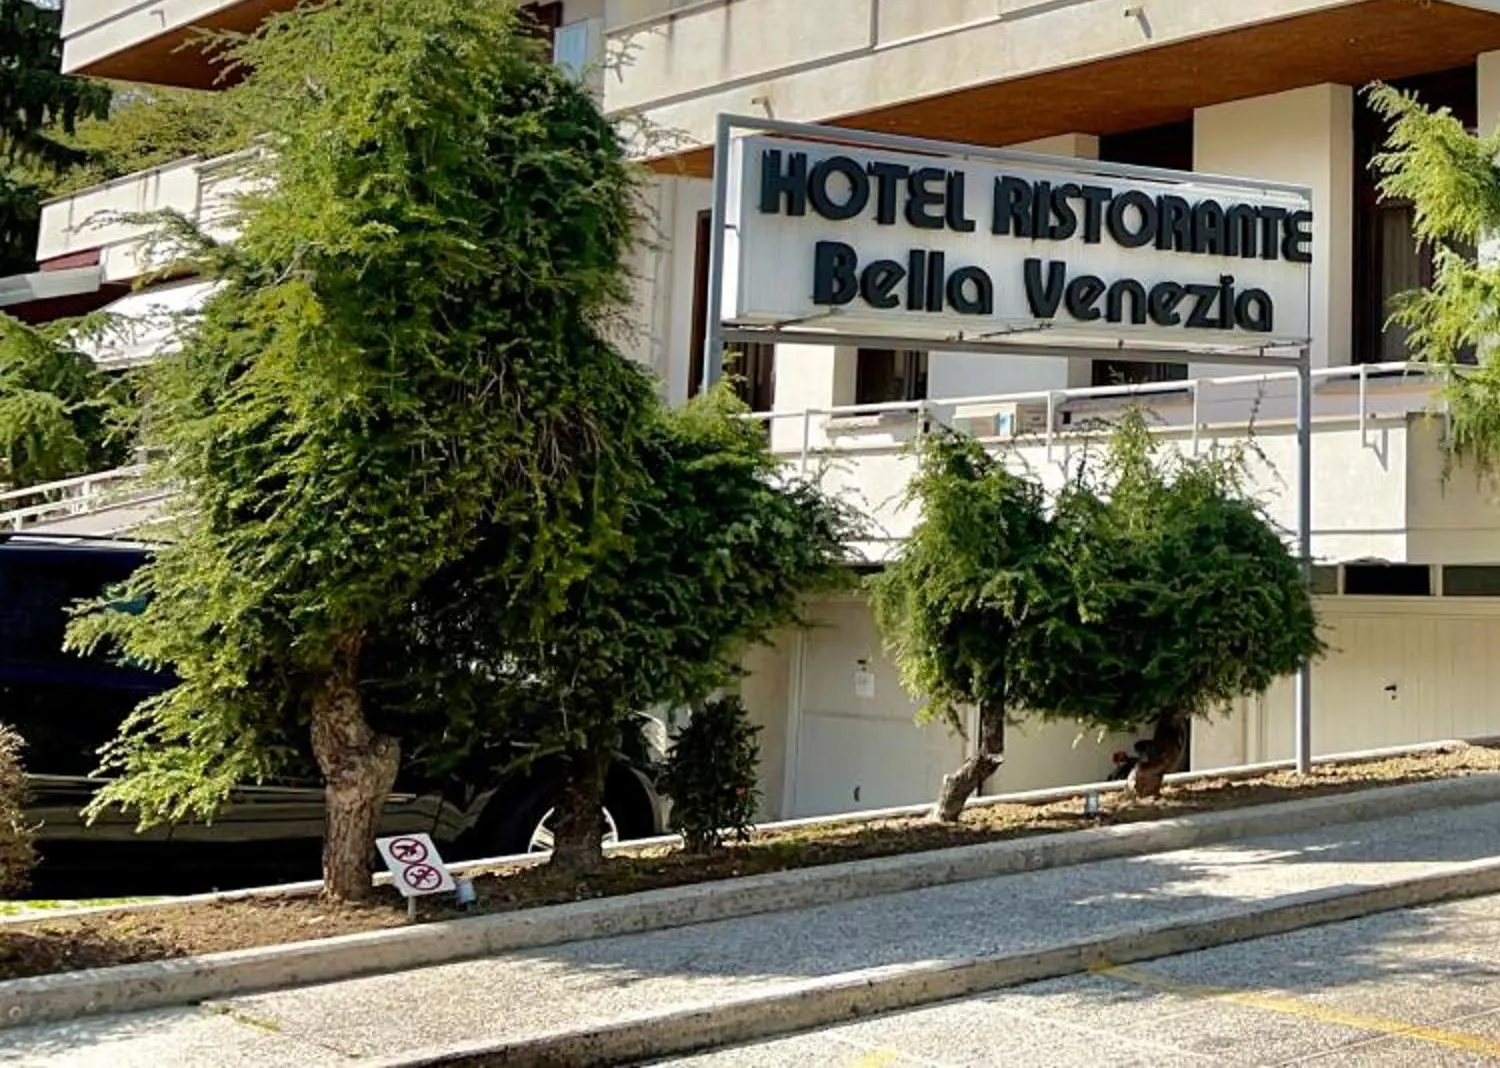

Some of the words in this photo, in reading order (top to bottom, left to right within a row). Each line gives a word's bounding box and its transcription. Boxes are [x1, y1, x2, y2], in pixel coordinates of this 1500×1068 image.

[761, 150, 976, 232] HOTEL
[993, 175, 1313, 263] RISTORANTE
[813, 241, 993, 315] Bella
[1023, 259, 1273, 333] Venezia
